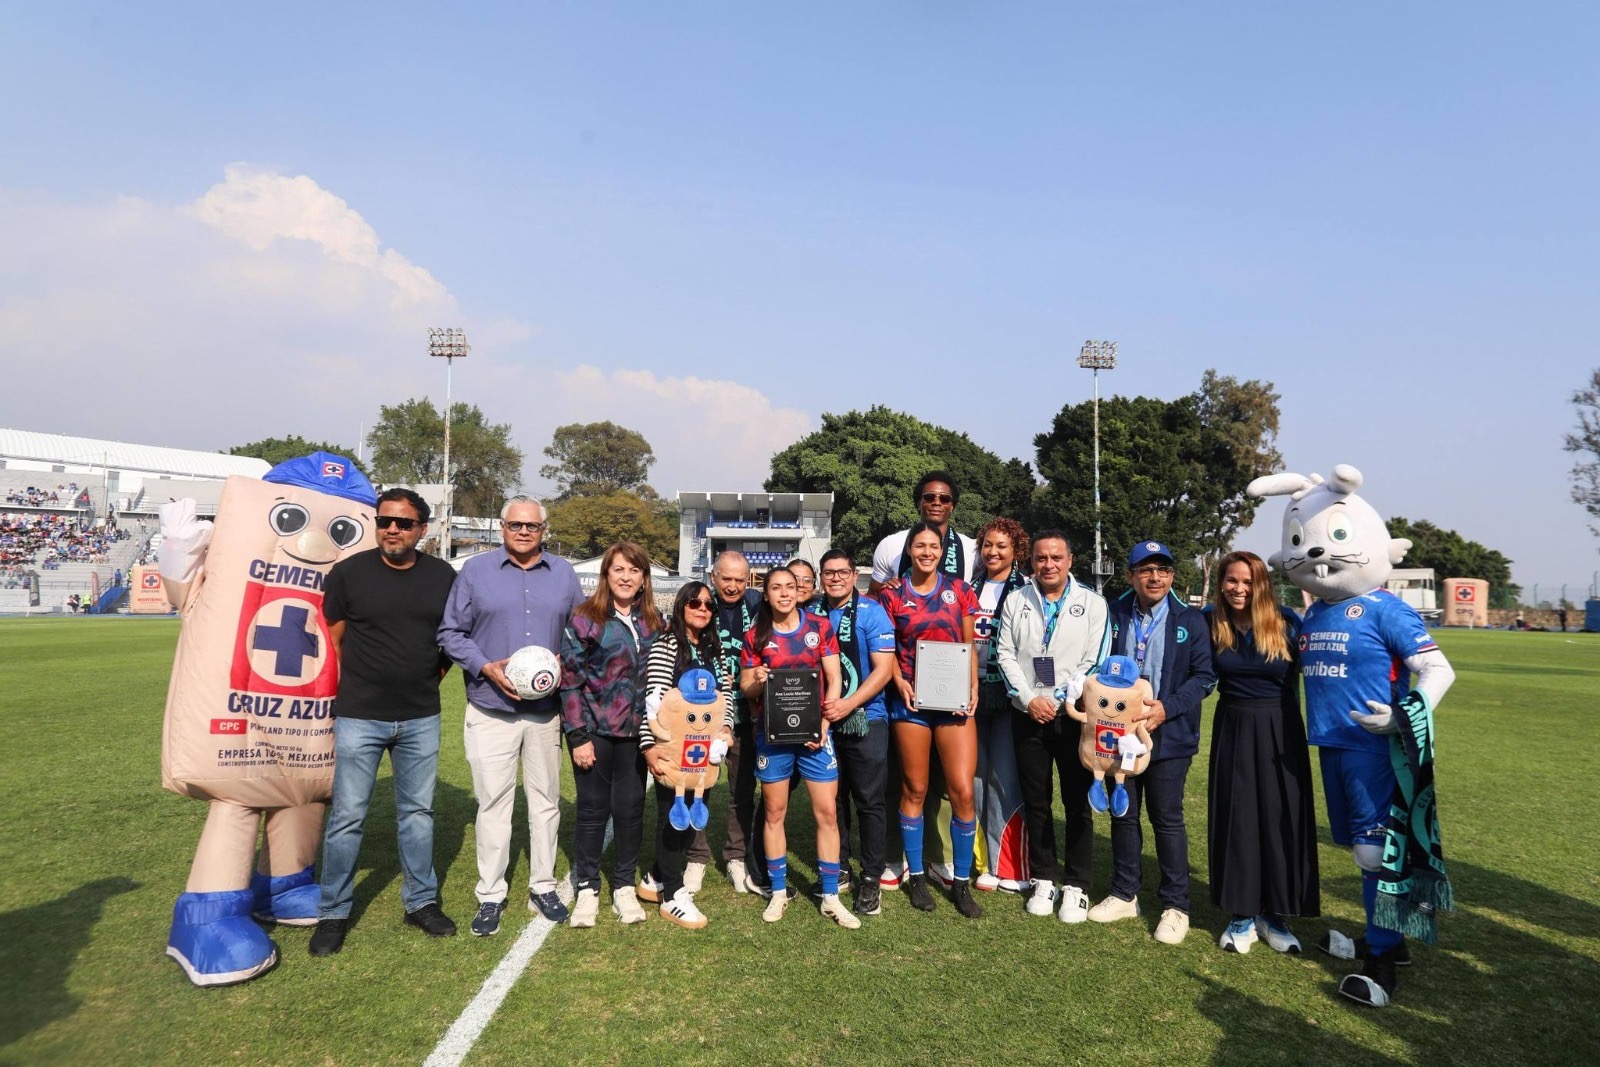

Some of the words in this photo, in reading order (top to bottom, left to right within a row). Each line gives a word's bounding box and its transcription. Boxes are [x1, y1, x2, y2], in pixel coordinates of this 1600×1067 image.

[945, 543, 957, 573] AZUL,
[249, 559, 326, 592] CEMEN
[1310, 632, 1349, 642] CEMENTO
[1310, 642, 1326, 651] CRUZ
[1326, 642, 1348, 653] AZUL
[1302, 661, 1348, 678] ovibet
[228, 692, 283, 718] CRUZ
[220, 721, 240, 731] CPC
[285, 728, 301, 736] TIPO
[303, 728, 308, 736] II
[1097, 719, 1125, 728] CEMENTO
[218, 749, 261, 759] EMPRESA
[288, 751, 335, 762] MEXICANA
